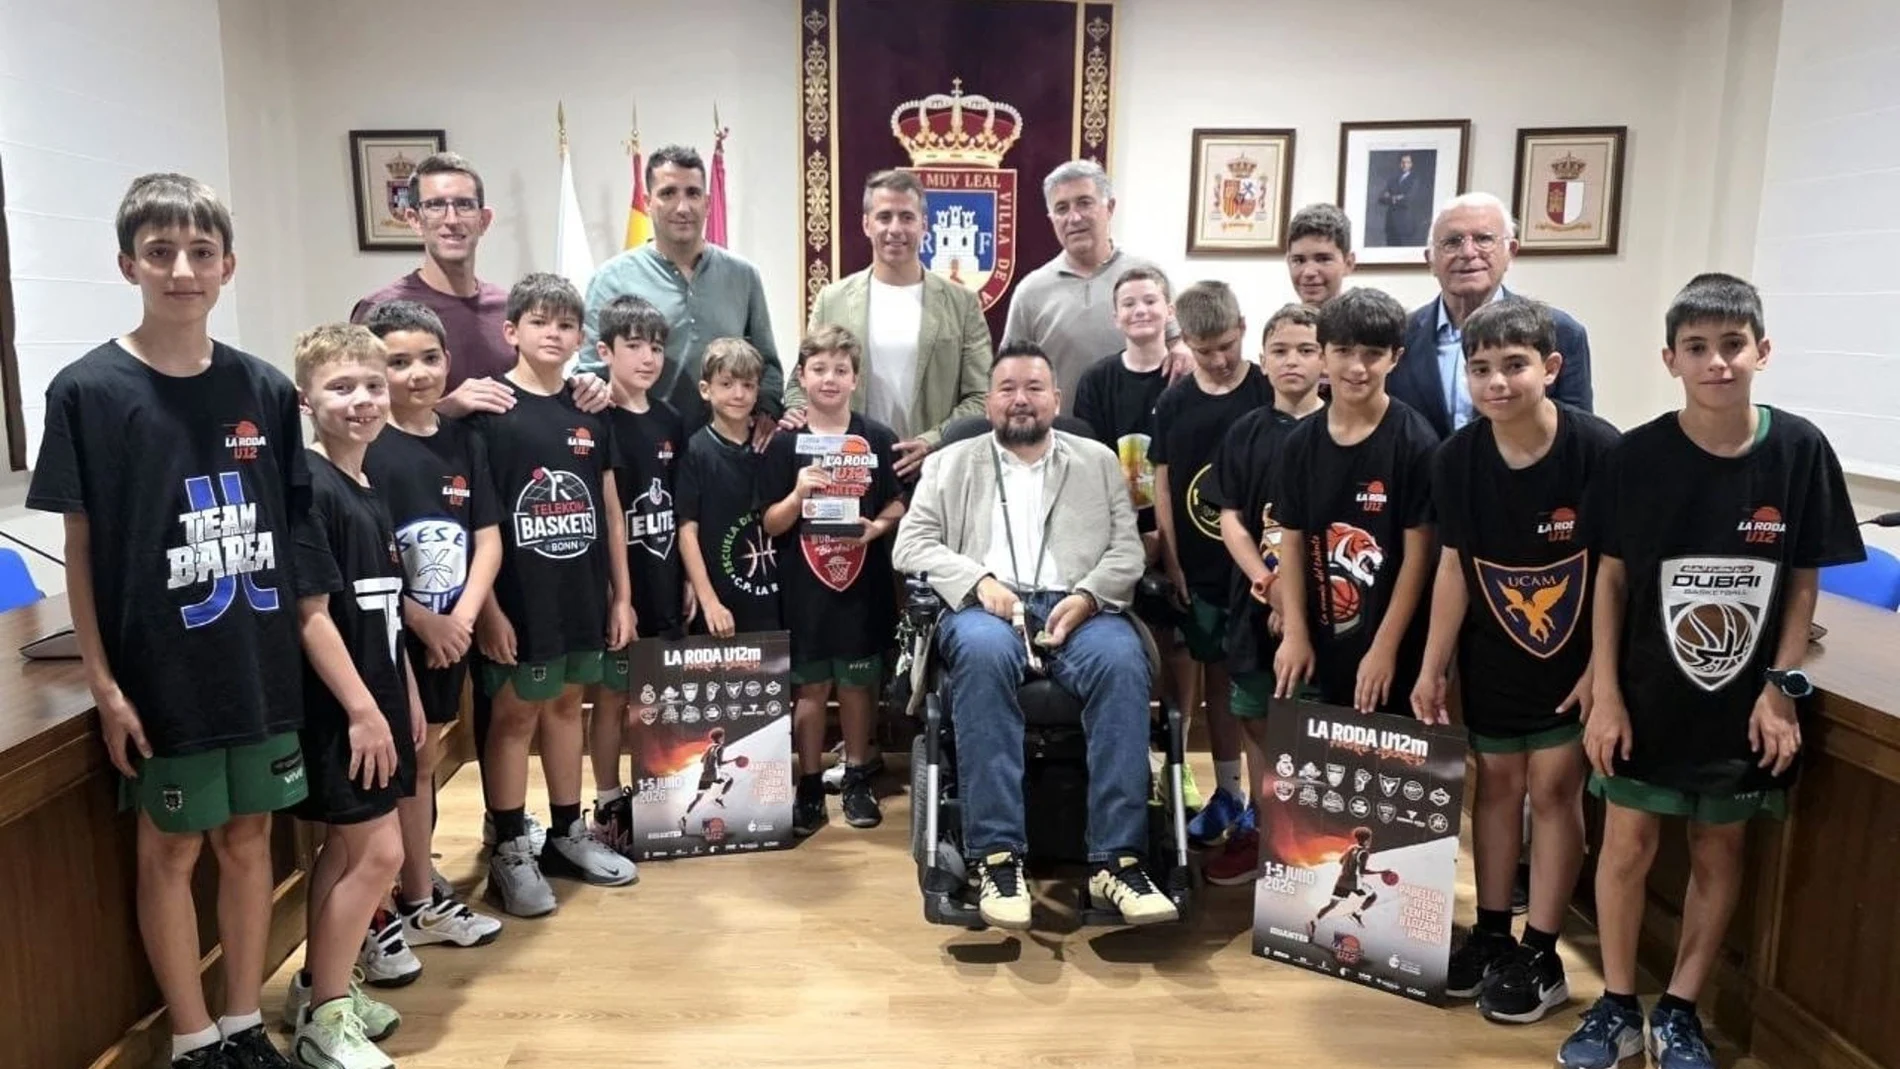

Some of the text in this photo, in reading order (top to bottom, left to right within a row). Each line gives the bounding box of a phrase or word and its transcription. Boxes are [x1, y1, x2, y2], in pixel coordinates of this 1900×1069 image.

[926, 173, 960, 188] MUY
[965, 174, 1001, 188] LEAL
[919, 231, 934, 254] R
[979, 232, 993, 255] F
[993, 192, 1012, 281] VILLA DE
[225, 435, 267, 447] LA RODA
[234, 446, 258, 460] U12
[825, 454, 879, 468] LA RODA
[532, 501, 587, 516] TELEKOM
[178, 502, 257, 544] TEAM
[520, 512, 594, 540] BASKETS
[632, 509, 675, 537] ELITE
[1537, 523, 1552, 534] LA
[1737, 521, 1786, 532] LA RODA
[1745, 531, 1777, 544] U12
[551, 541, 579, 552] BONN
[721, 526, 741, 575] ESCUELA
[1508, 575, 1557, 587] UCAM
[1672, 575, 1763, 588] DUBAI
[755, 586, 770, 596] LA
[664, 646, 762, 666] LA RODA U12m
[1307, 717, 1329, 739] LA
[1330, 722, 1378, 749] RODA
[1381, 730, 1428, 758] U12m
[637, 777, 656, 791] 1-5
[638, 790, 667, 802] 2026
[1263, 860, 1284, 877] 1-5
[1263, 875, 1296, 896] 2026
